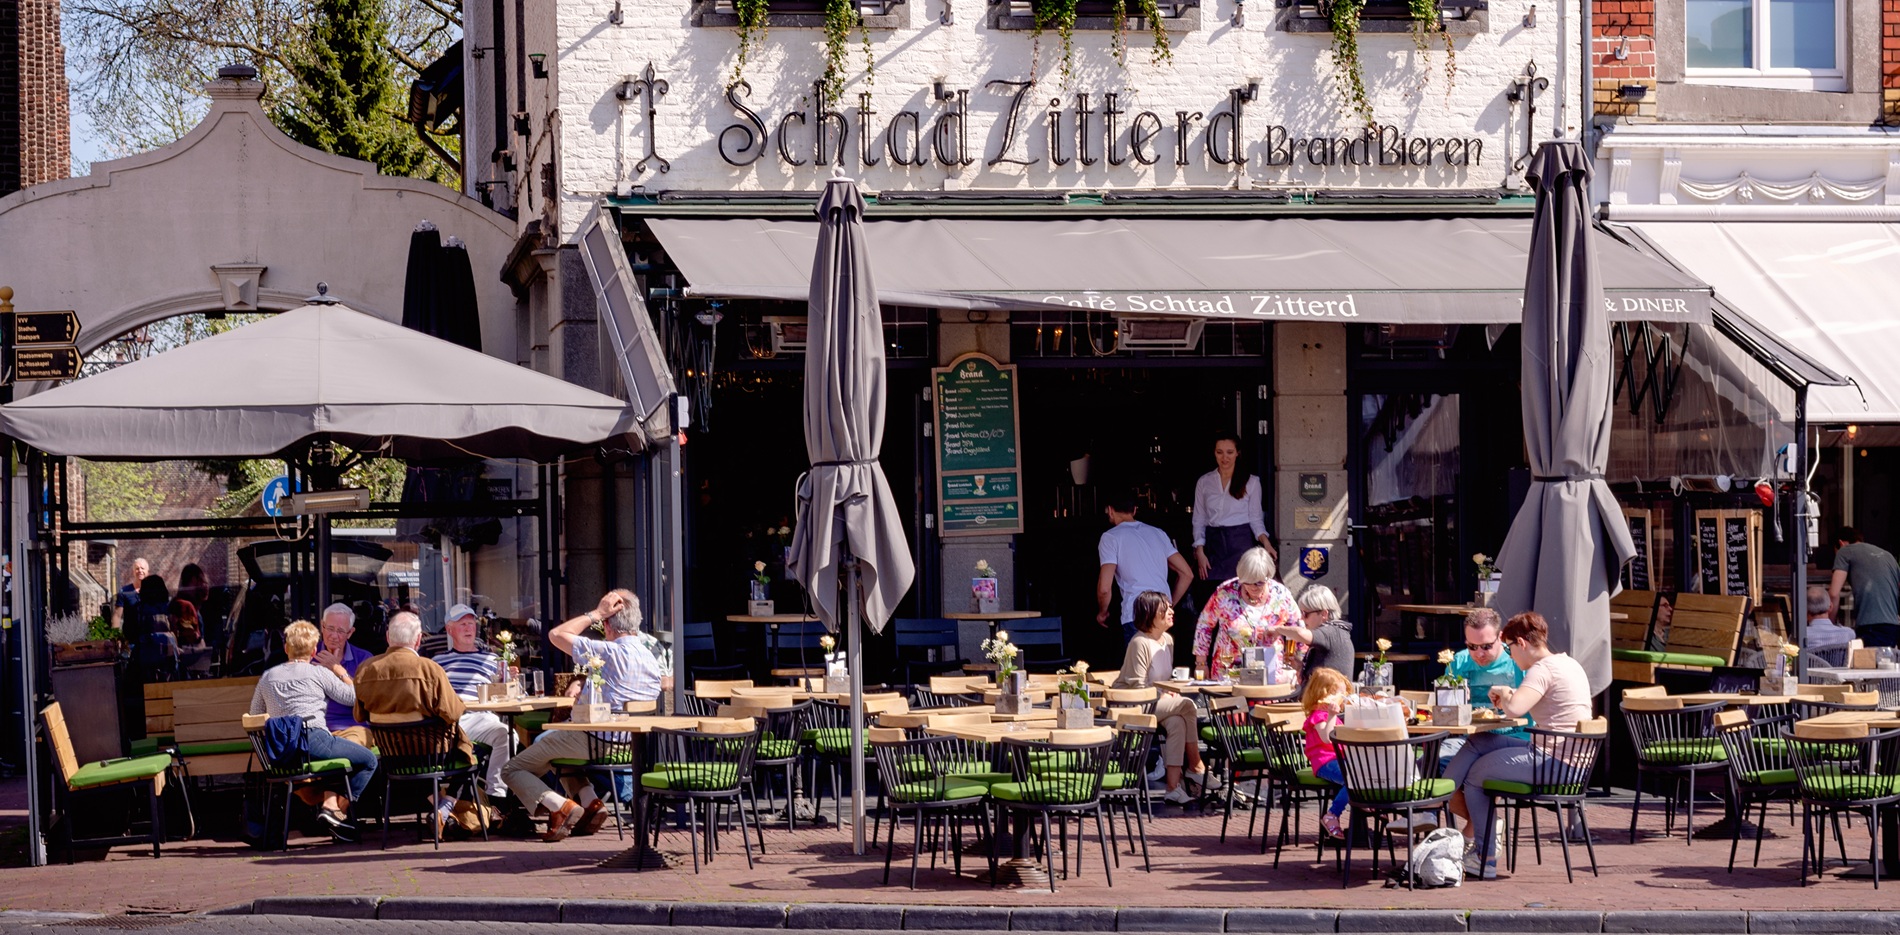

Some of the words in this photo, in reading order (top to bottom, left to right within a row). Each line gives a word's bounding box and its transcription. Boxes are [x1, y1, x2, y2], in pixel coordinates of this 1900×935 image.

[718, 80, 974, 166] Schtad
[985, 79, 1249, 166] Zitterd
[1378, 123, 1483, 166] Bieren
[1126, 295, 1236, 314] Schtad
[1250, 294, 1359, 317] Zitterd
[1604, 298, 1618, 311] &
[1622, 297, 1690, 313] DINER
[960, 370, 983, 379] Brand
